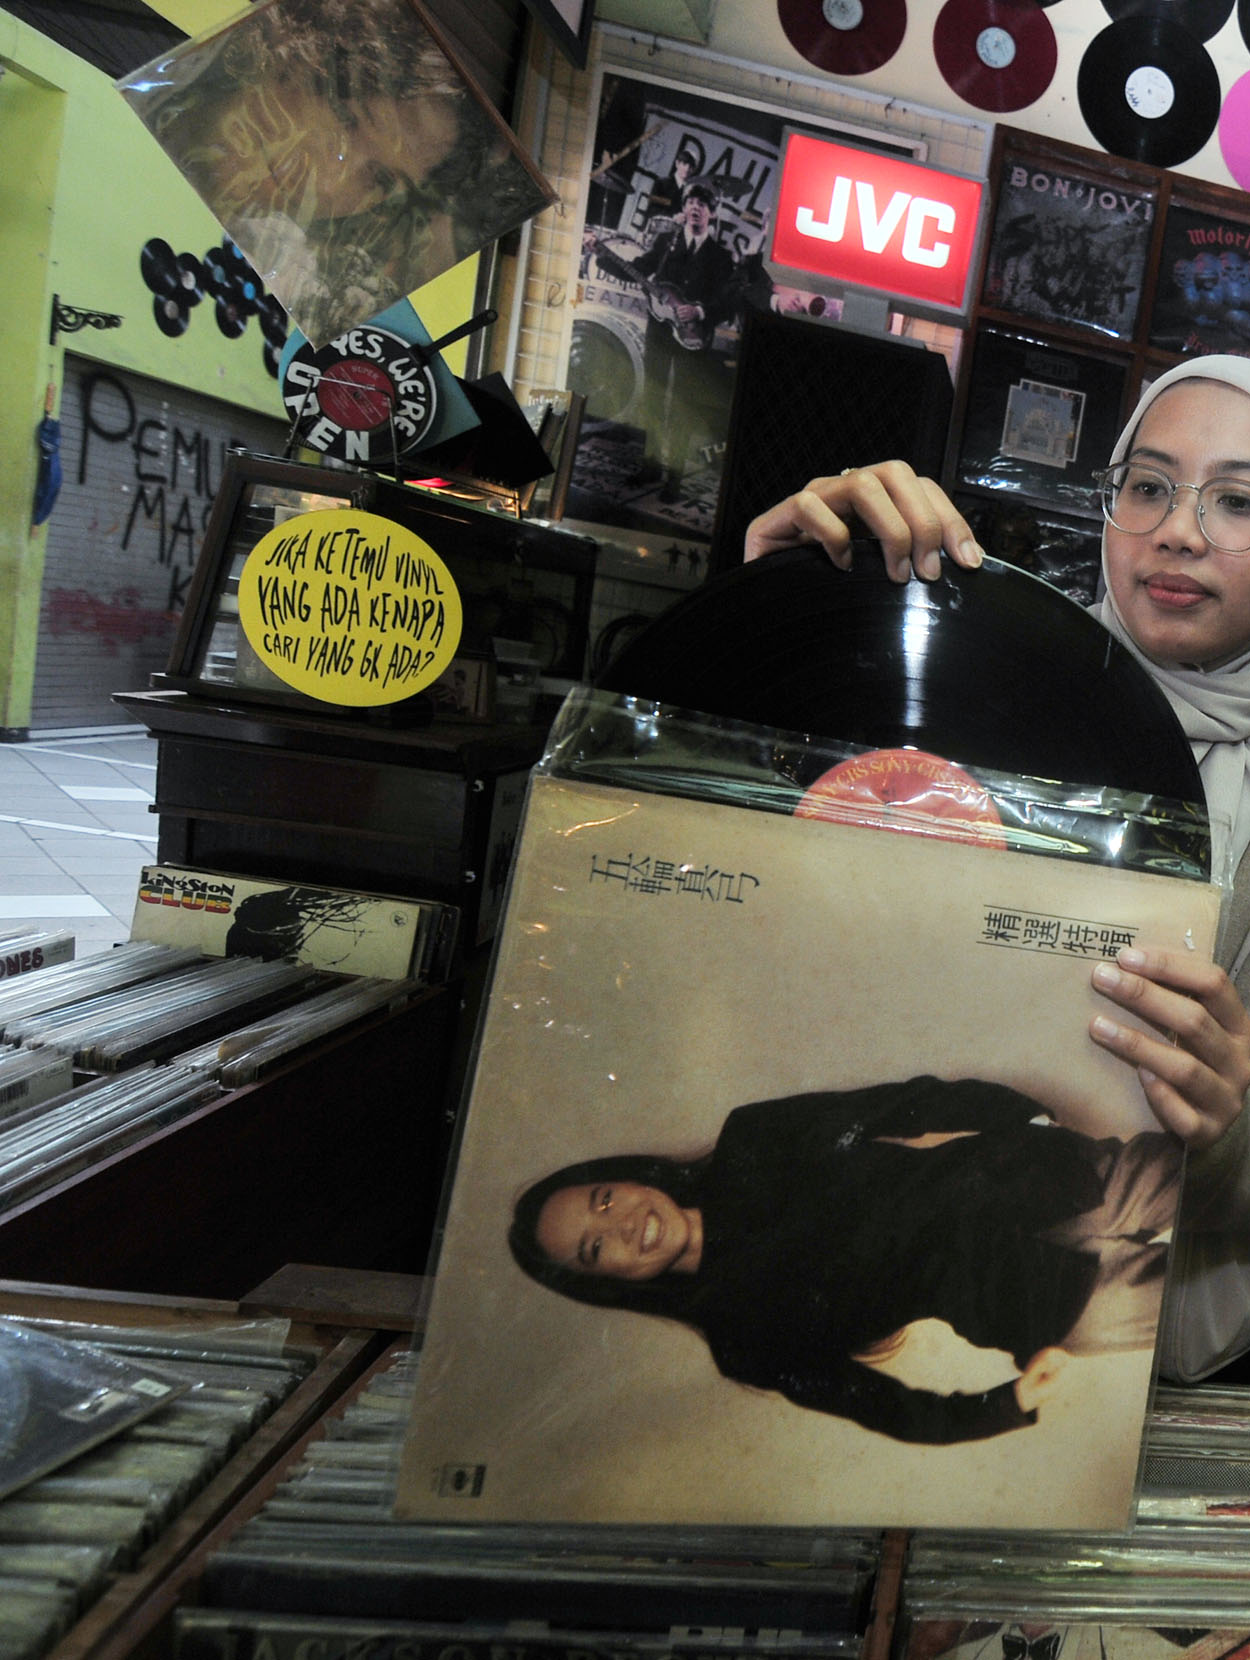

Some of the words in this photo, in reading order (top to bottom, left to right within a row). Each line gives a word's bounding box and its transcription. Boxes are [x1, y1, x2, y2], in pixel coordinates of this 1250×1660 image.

[795, 175, 956, 269] JVC
[1010, 166, 1071, 199] BON
[1082, 187, 1153, 221] JOVI
[78, 372, 247, 501] PEMU
[264, 529, 313, 574] JIKA
[314, 528, 391, 590] KETEMU
[395, 552, 444, 595] VINYL
[258, 575, 311, 631] YANG
[320, 582, 360, 633] ADA
[369, 592, 445, 648] KENAPA
[263, 633, 301, 664] CARI
[305, 634, 355, 677] YANG
[360, 640, 383, 682] GK
[382, 642, 435, 689] ADA?
[139, 884, 233, 914] CLUB
